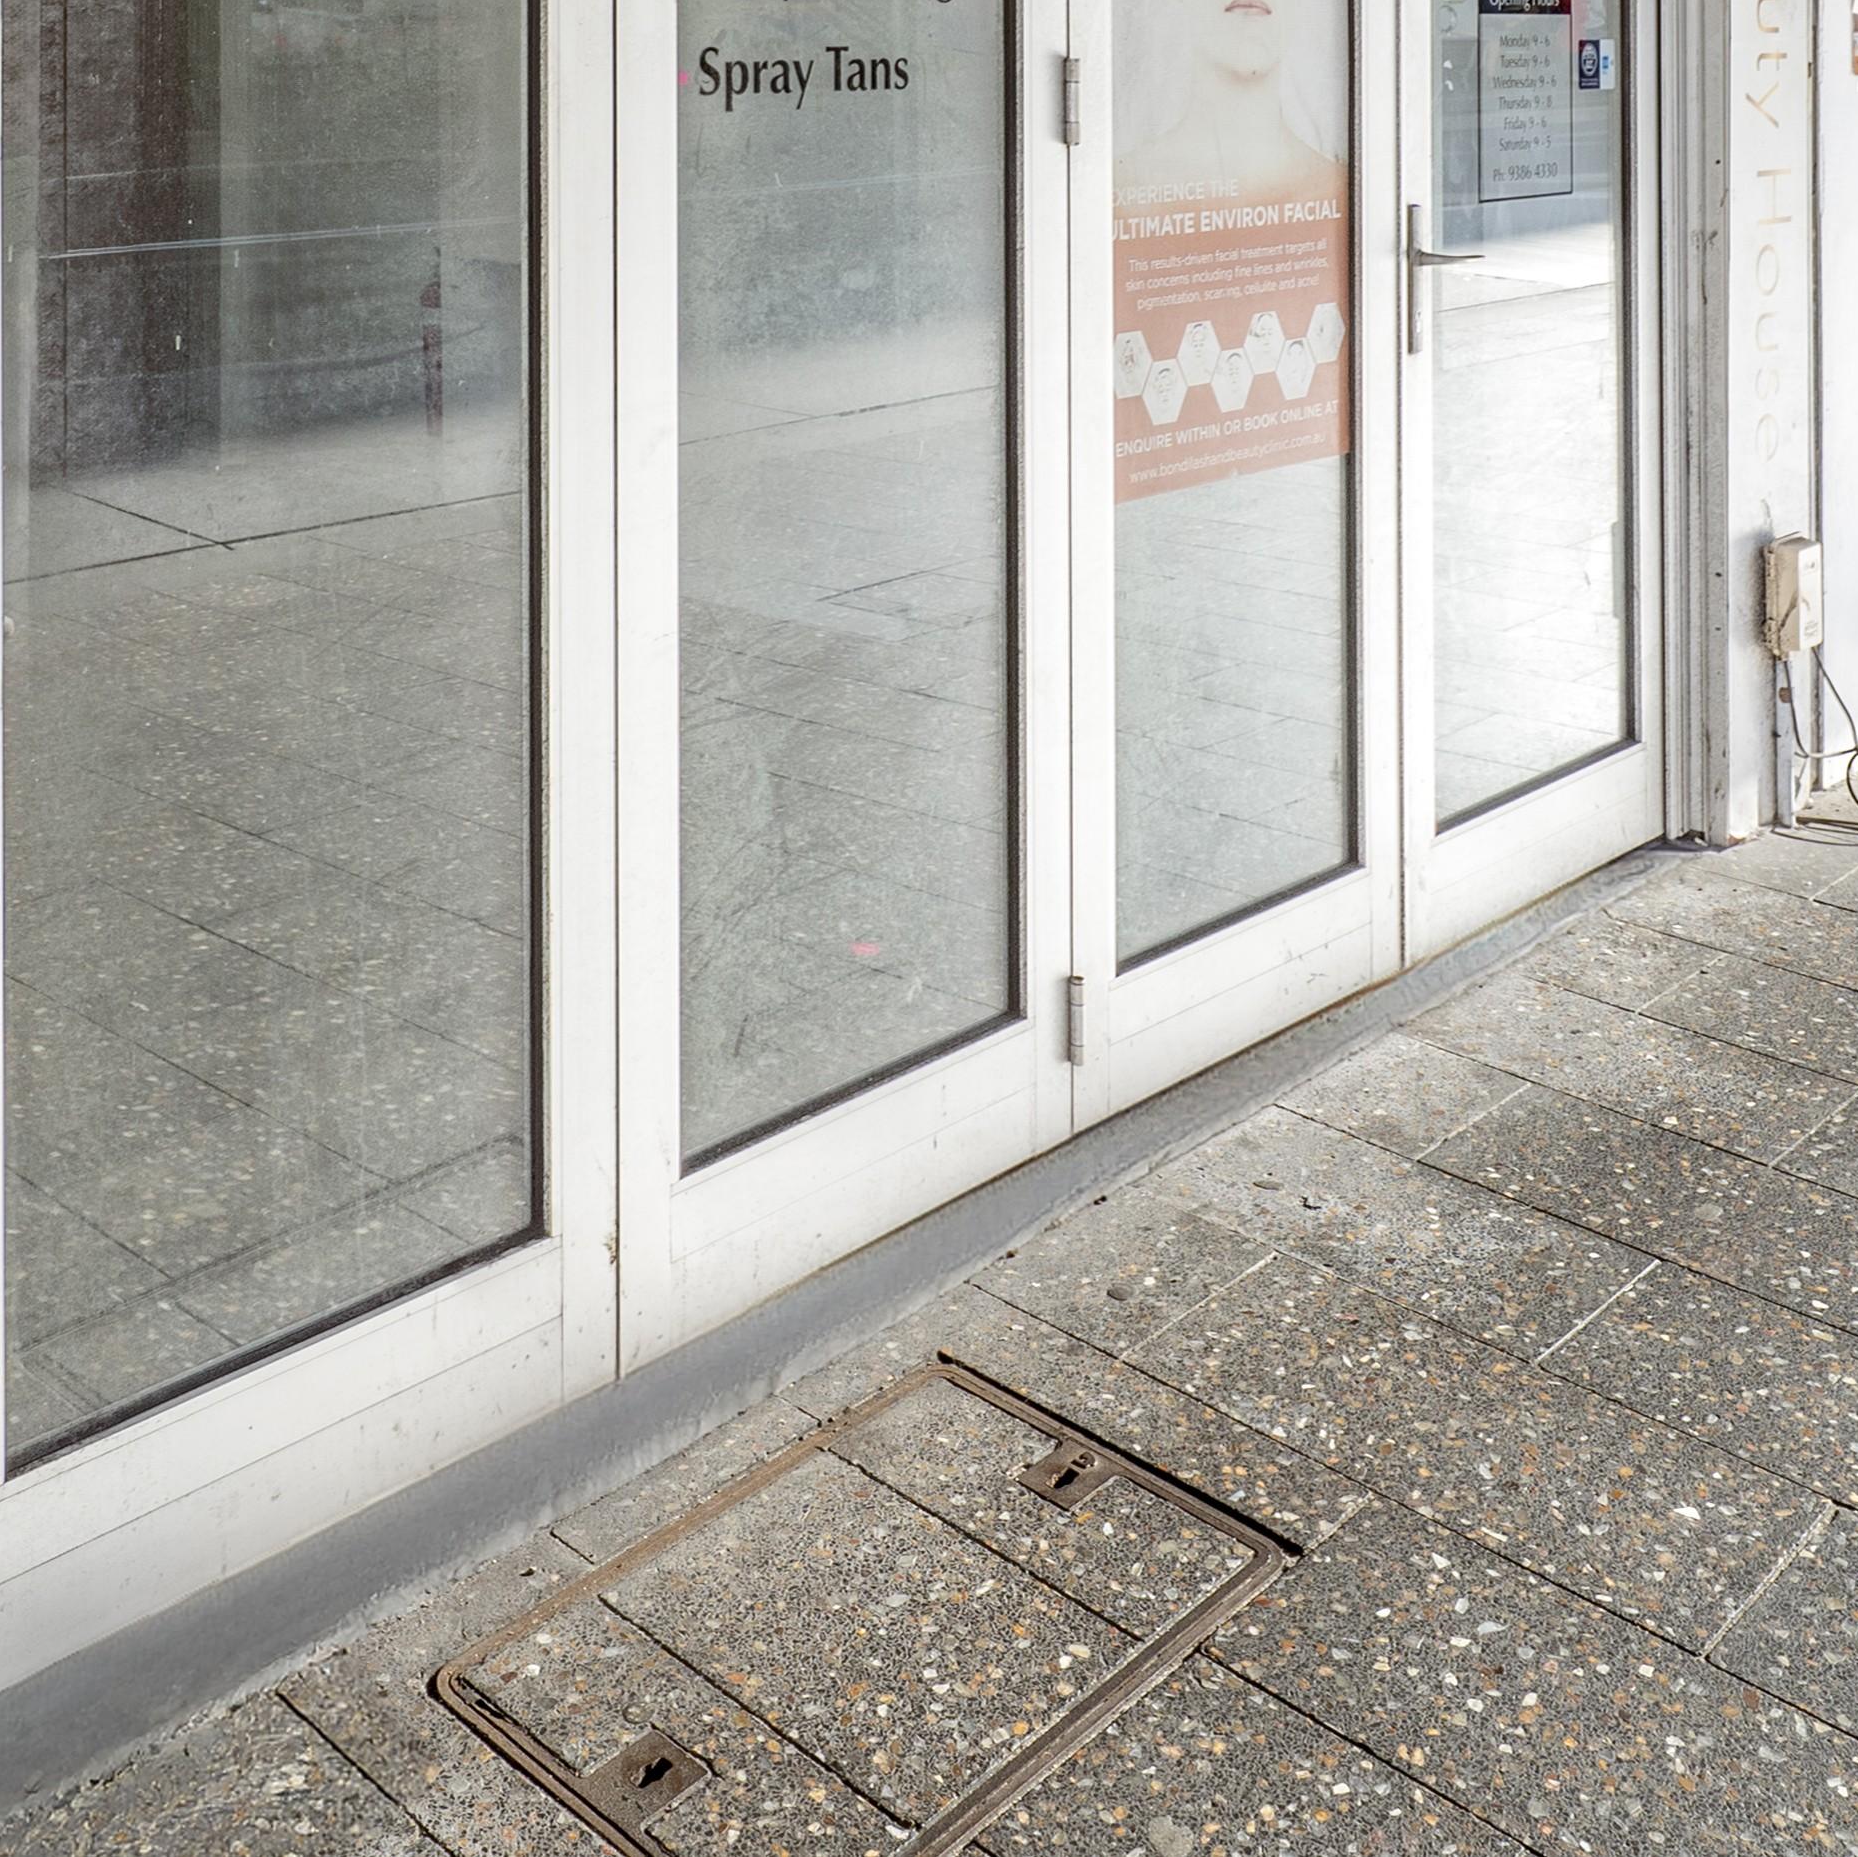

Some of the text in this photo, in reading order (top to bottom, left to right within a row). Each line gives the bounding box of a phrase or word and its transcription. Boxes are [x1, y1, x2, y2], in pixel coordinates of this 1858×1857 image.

[1499, 33, 1530, 50] Monday
[1500, 54, 1530, 69] Tuesday
[699, 46, 909, 112] Spray Tans
[1493, 74, 1537, 92] Wednesday
[1499, 95, 1532, 111] Thursday
[1504, 115, 1527, 132] Friday
[1211, 178, 1240, 199] THE
[1200, 205, 1280, 232] ENVIRON
[1284, 199, 1341, 223] FACIAL
[1129, 238, 1327, 273] This results-driven facial treatment targets all
[1126, 278, 1145, 292] skin
[1147, 274, 1190, 288] concerns
[1192, 268, 1233, 286] including
[1235, 265, 1251, 278] fine
[1253, 262, 1273, 276] lines
[1275, 260, 1292, 273] and
[1279, 277, 1295, 290] and
[1751, 169, 1789, 462] House
[1115, 399, 1340, 458] ENQUIRE WITHIN OR BOOK ONLINE AT
